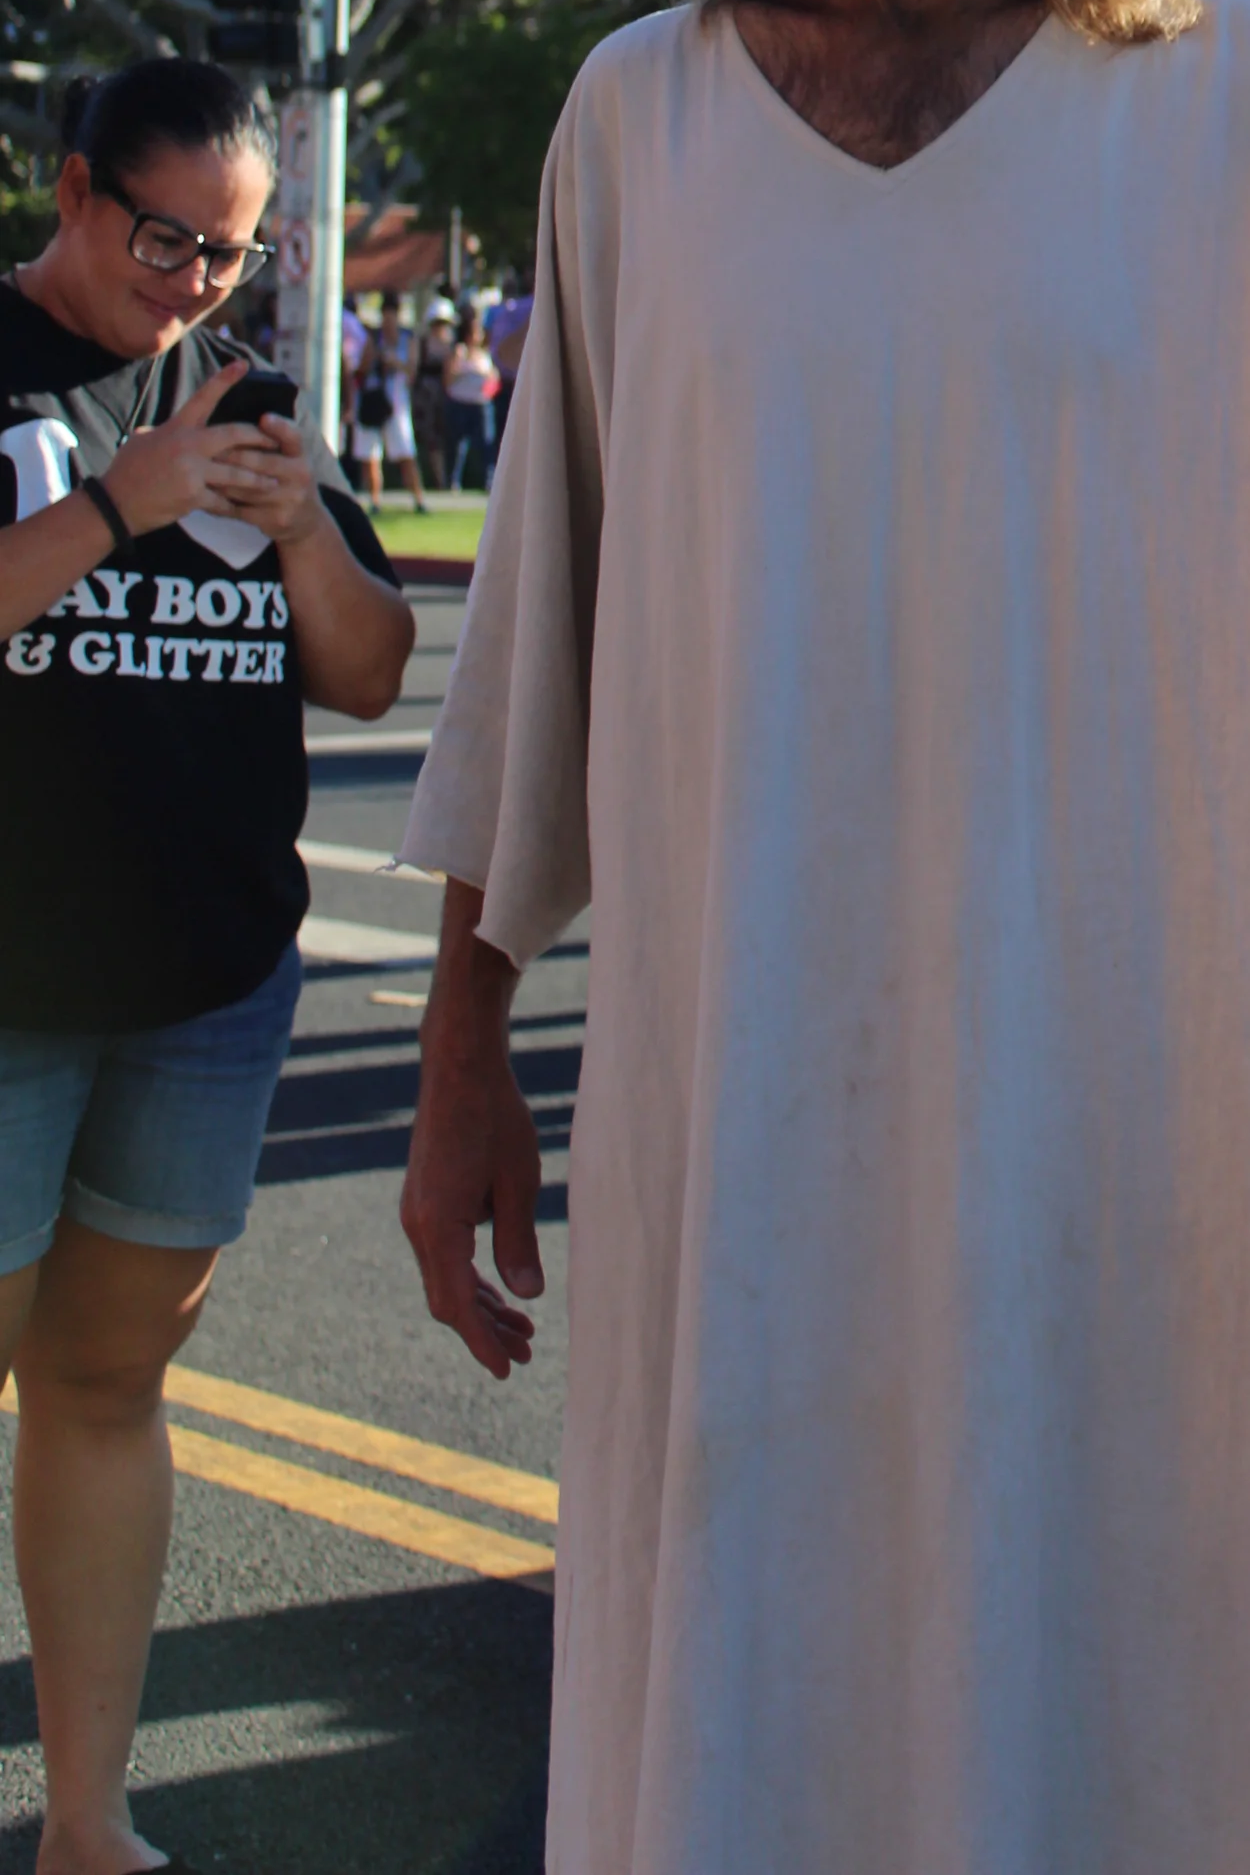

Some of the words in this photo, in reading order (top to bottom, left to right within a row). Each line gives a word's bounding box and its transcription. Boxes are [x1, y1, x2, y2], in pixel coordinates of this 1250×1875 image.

[47, 569, 143, 619] AY
[150, 575, 290, 630] BOYS
[5, 631, 56, 676] &
[68, 631, 287, 684] GLITTER
